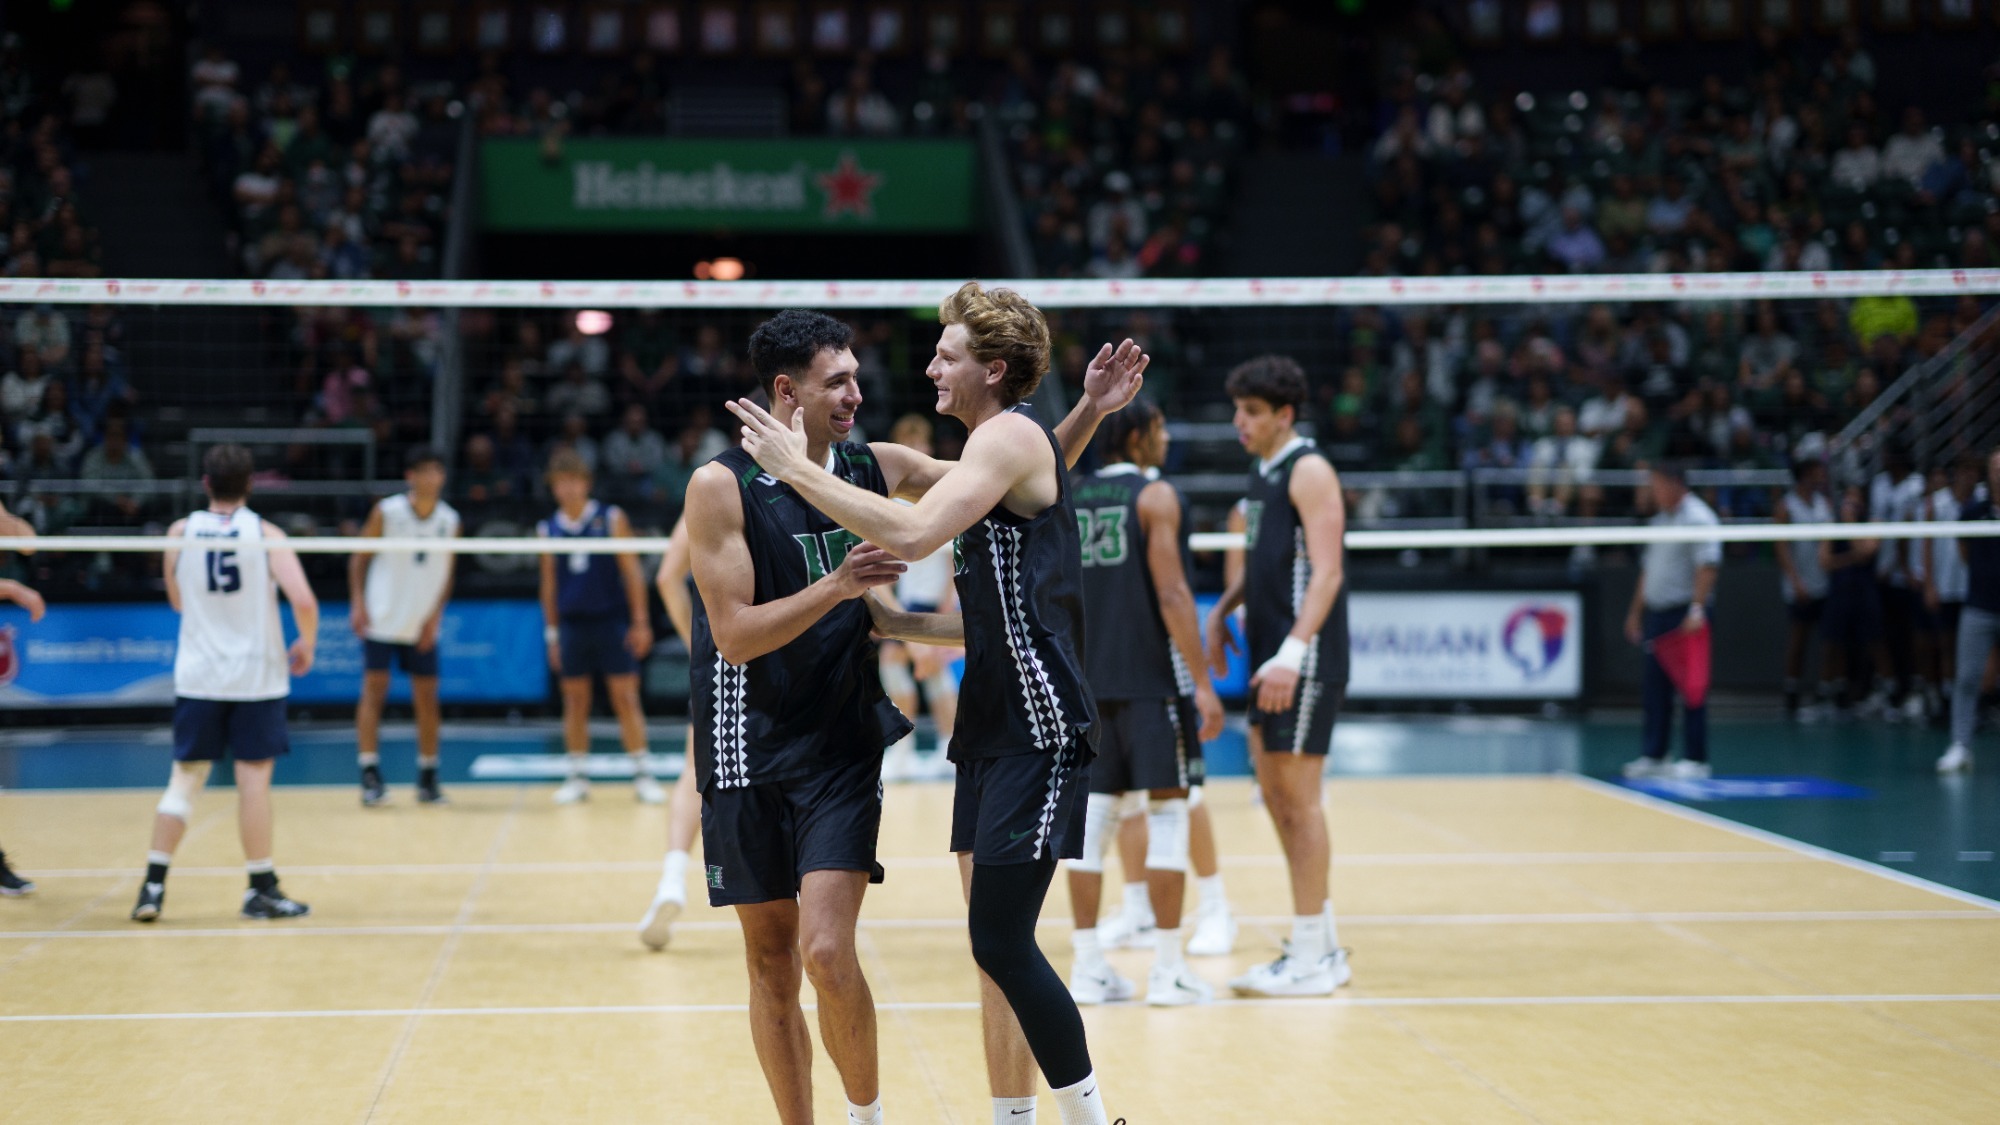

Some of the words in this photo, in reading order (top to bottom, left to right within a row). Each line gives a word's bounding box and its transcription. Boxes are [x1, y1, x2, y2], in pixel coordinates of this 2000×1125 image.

[573, 160, 806, 209] Heineken
[1075, 505, 1129, 568] 23
[206, 551, 242, 593] 15
